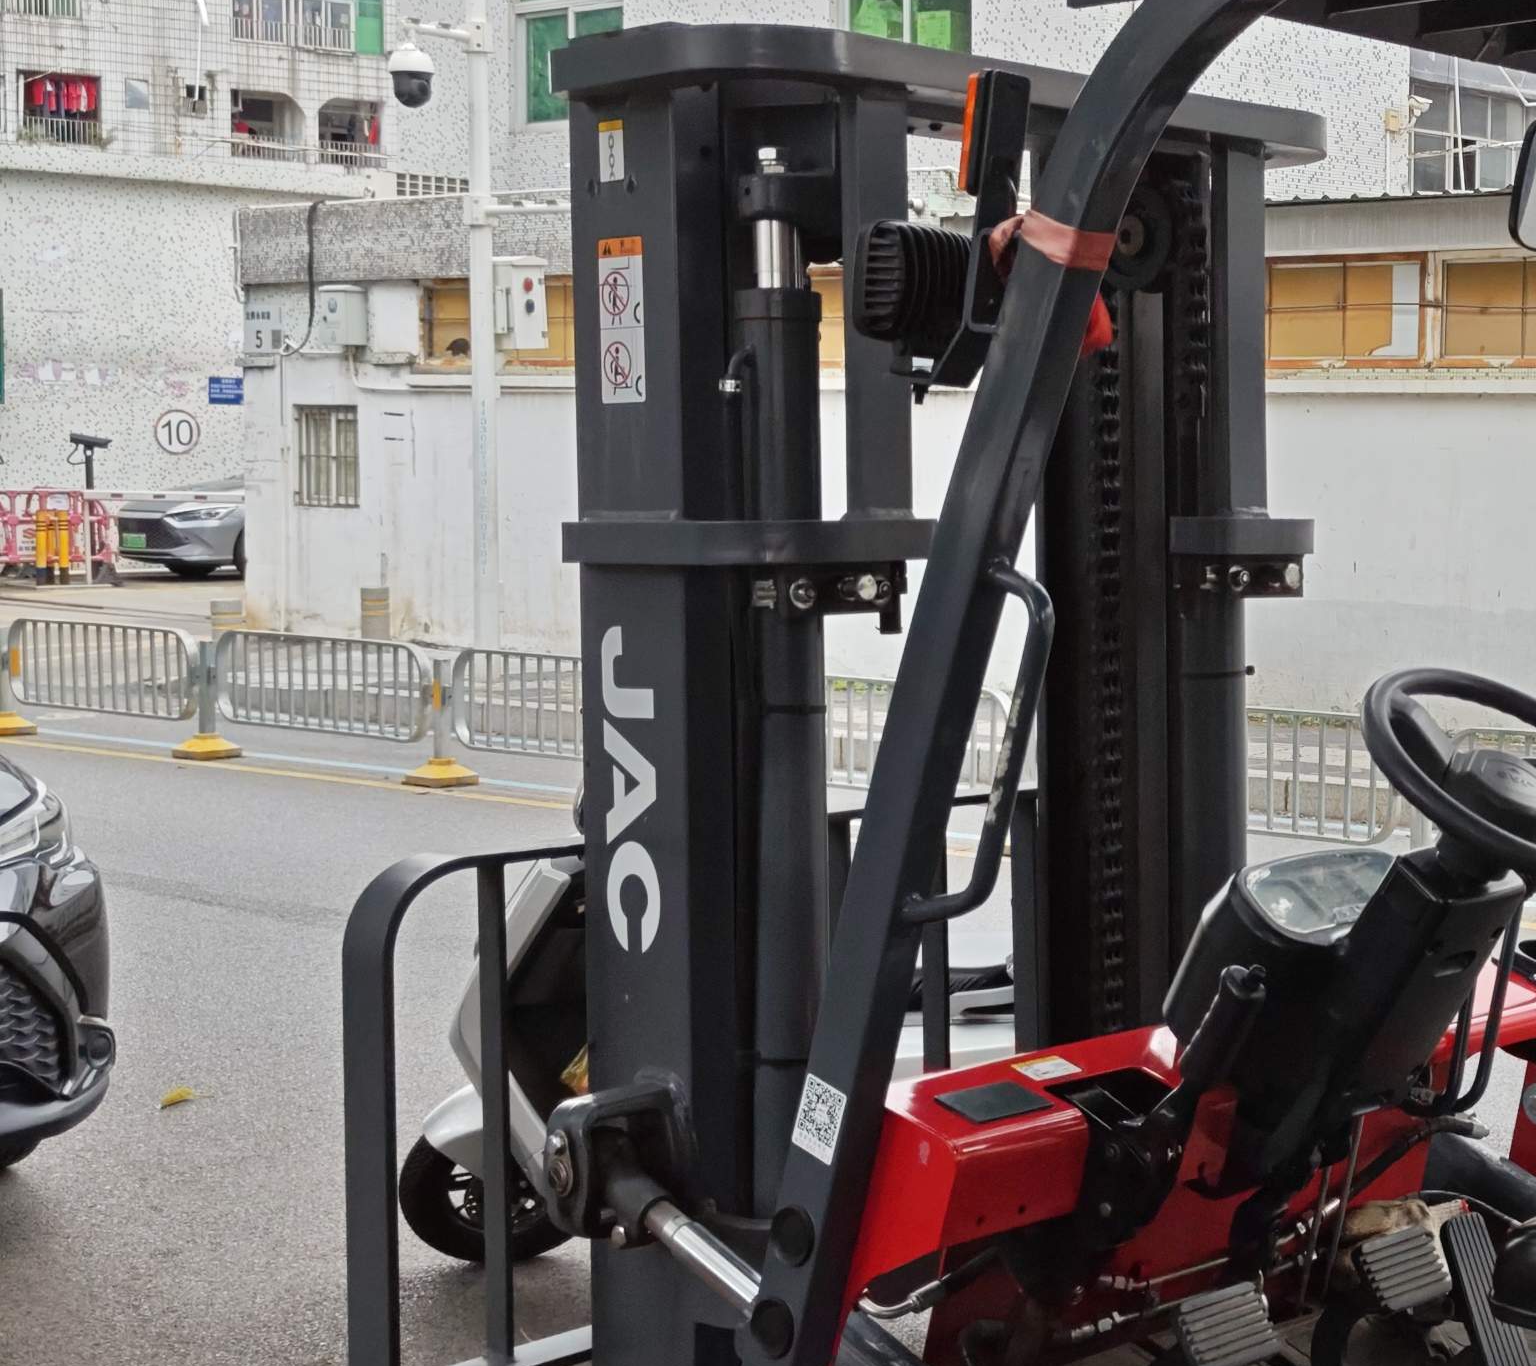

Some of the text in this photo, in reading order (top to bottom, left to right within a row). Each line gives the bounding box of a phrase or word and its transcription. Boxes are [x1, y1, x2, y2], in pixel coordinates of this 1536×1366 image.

[255, 330, 263, 349] 5
[161, 419, 193, 446] 10
[601, 625, 661, 954] JAC
